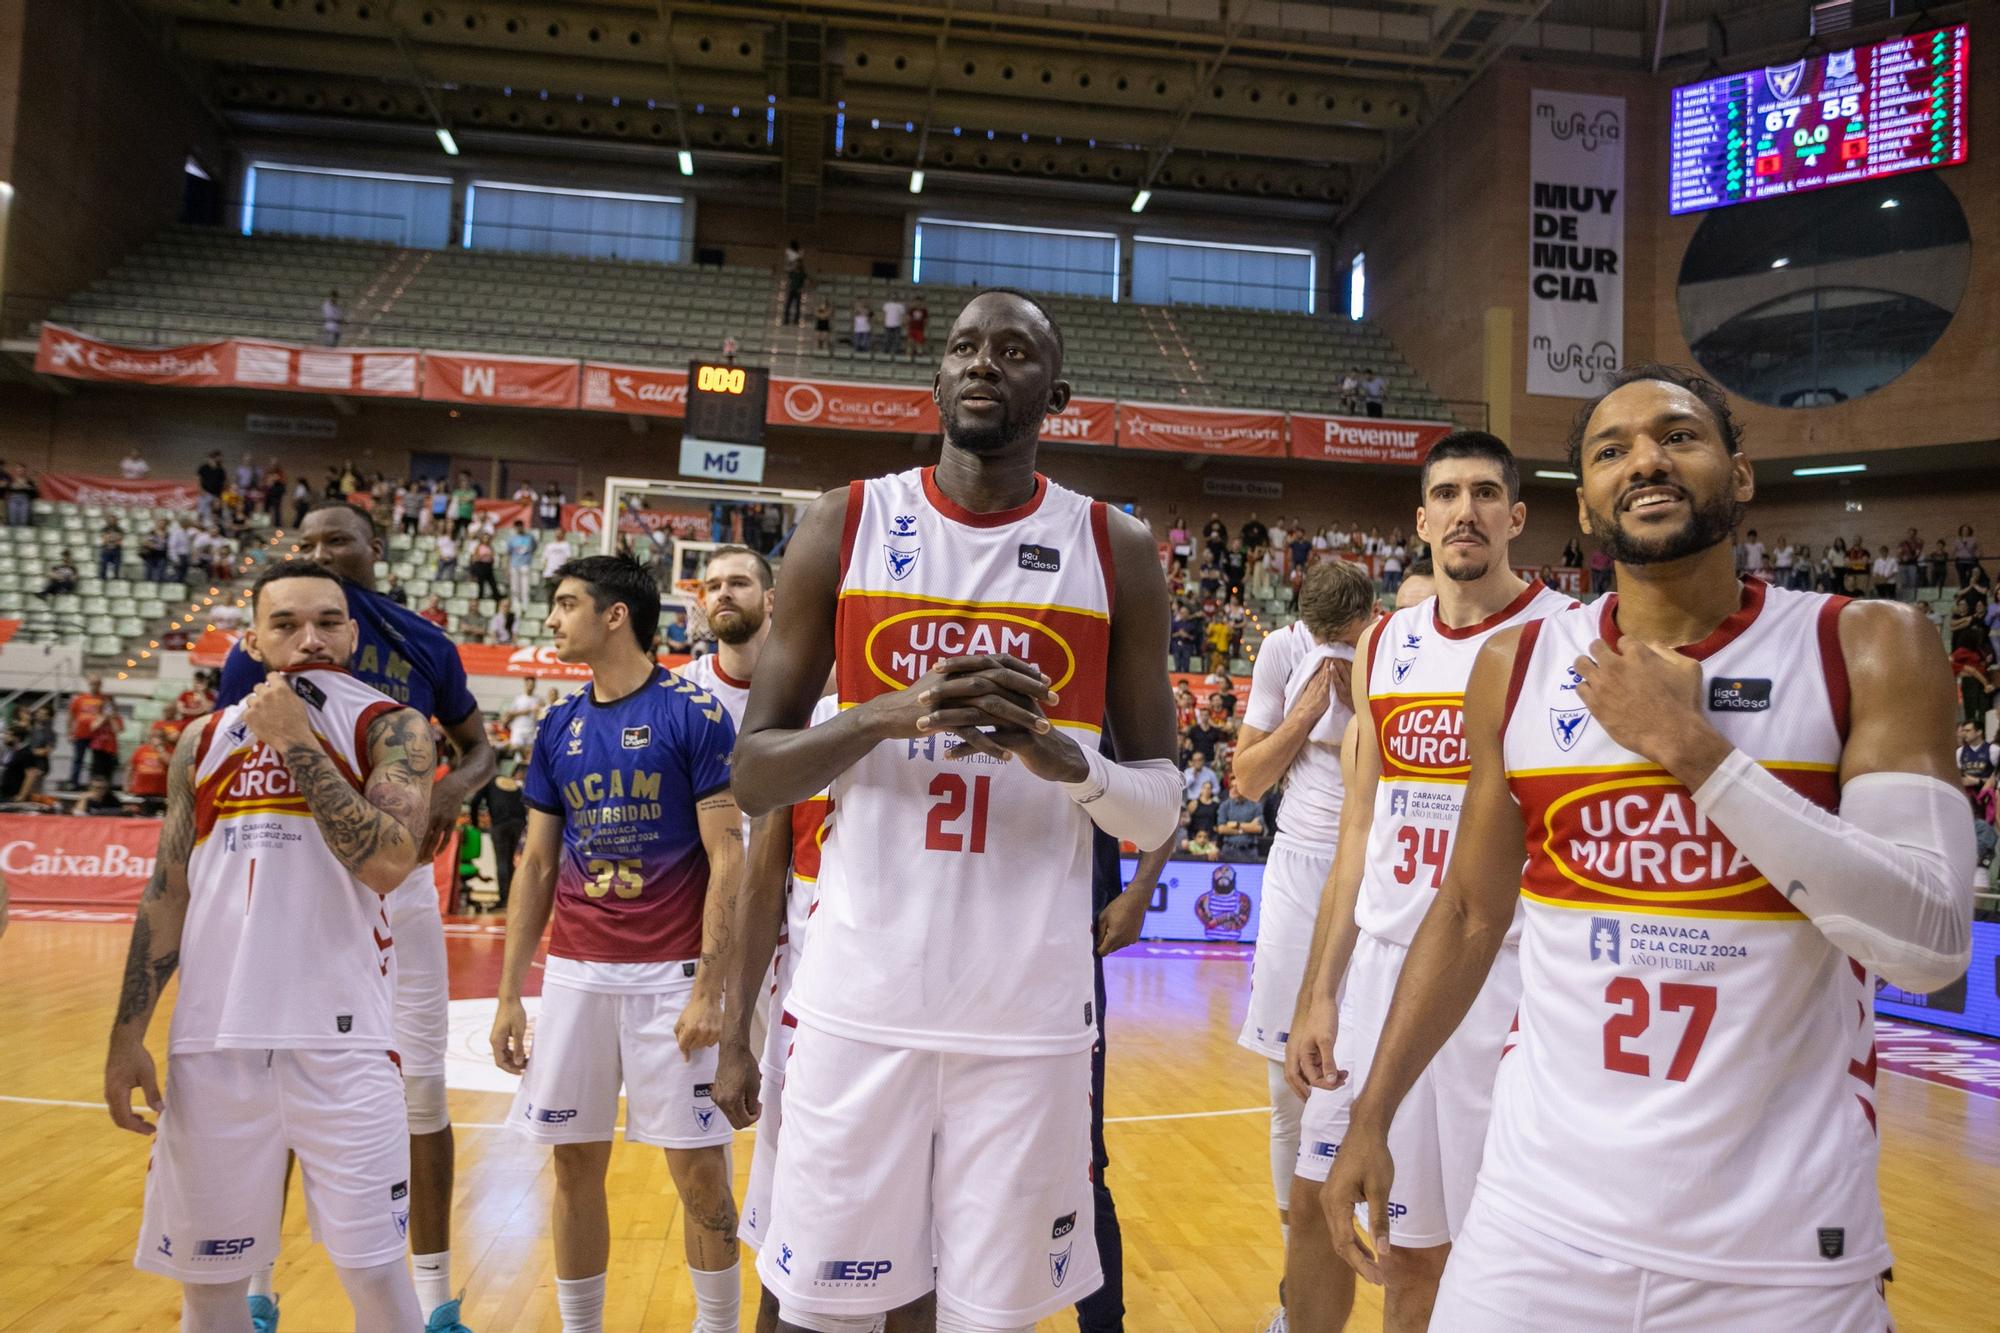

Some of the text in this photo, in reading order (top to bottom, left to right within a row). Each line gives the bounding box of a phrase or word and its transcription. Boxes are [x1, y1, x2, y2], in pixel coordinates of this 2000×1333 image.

[1765, 107, 1801, 132] 67
[1822, 94, 1860, 120] 55
[1793, 124, 1829, 147] 0.0
[1534, 182, 1618, 214] MUY
[1534, 213, 1577, 241] DE
[1534, 242, 1617, 275] MUR
[1533, 273, 1598, 304] CIA
[86, 348, 219, 376] CaixaBank
[1325, 421, 1419, 448] Prevemur
[1022, 559, 1058, 571] endesa
[909, 622, 1030, 659] UCAM
[1714, 688, 1739, 700] liga
[1714, 697, 1769, 708] endesa
[1389, 736, 1471, 764] MURCI
[563, 769, 661, 810] UCAM
[1412, 791, 1452, 801] CARAVACA
[925, 772, 991, 853] 21
[1411, 801, 1420, 809] DE
[1421, 802, 1430, 810] LA
[1431, 803, 1449, 812] CRUZ
[1394, 825, 1450, 889] 34
[583, 858, 644, 899] 35
[1630, 923, 1711, 941] CARAVACA
[1630, 938, 1748, 958] DE LA CRUZ 2024
[1628, 952, 1716, 973] AÑO JUBILAR
[1603, 976, 1718, 1083] 27
[547, 1109, 578, 1124] ESP
[1054, 1222, 1073, 1237] acb
[212, 1237, 255, 1256] ESP
[839, 1260, 893, 1281] ESP
[814, 1280, 877, 1289] SOLUTIONS
